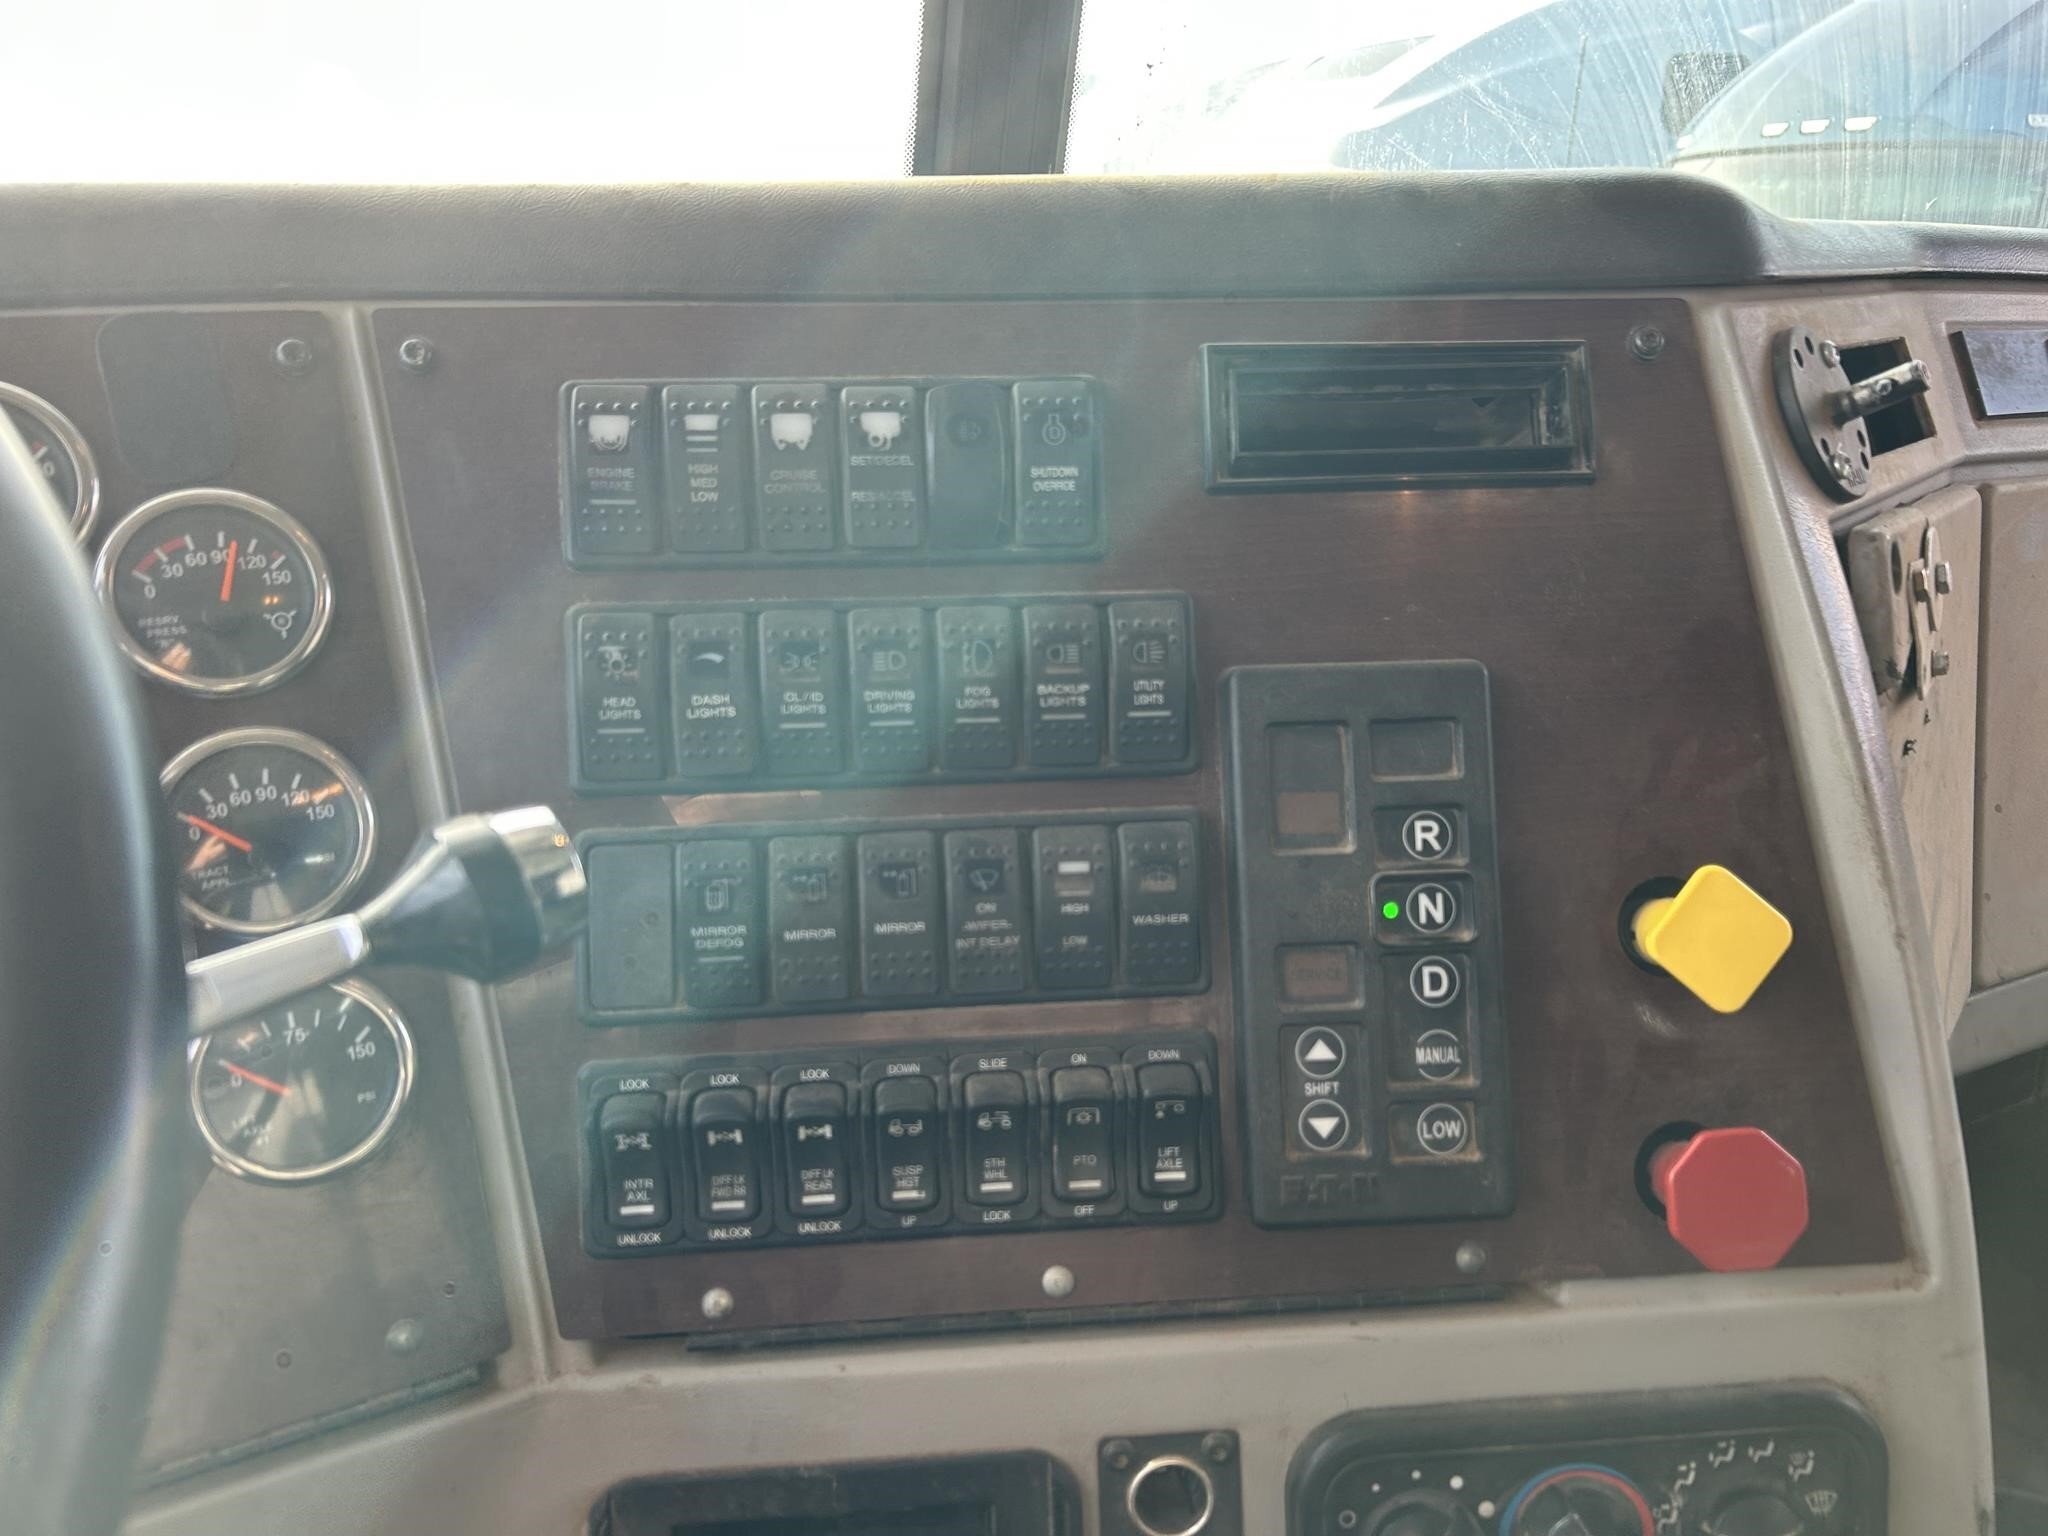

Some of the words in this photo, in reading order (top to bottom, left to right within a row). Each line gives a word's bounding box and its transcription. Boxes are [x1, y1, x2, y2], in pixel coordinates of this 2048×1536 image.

[687, 463, 719, 475] HIGH
[1030, 465, 1080, 479] SHUTDOWN
[690, 477, 718, 489] MED
[690, 490, 719, 504] LOW
[185, 552, 208, 567] 60
[237, 554, 266, 570] 120
[161, 563, 184, 579] 30
[262, 571, 292, 587] 150
[144, 585, 156, 600] 0
[1037, 683, 1090, 696] BACKUP
[603, 697, 636, 708] HEAD
[691, 695, 731, 706] DASH
[957, 698, 999, 709] LIGHTS
[1040, 696, 1086, 708] LIGHTS
[1133, 693, 1165, 706] LIGHTS
[599, 709, 642, 720] LIGHTS
[686, 707, 737, 719] LIGHTS
[782, 704, 827, 715] LIGHTS
[868, 702, 912, 714] LIGHTS
[229, 790, 252, 805] 60
[254, 786, 277, 801] 90
[206, 804, 228, 819] 30
[305, 803, 336, 821] 150
[188, 827, 201, 841] 0
[1413, 819, 1442, 853] R
[976, 902, 997, 914] ON
[1061, 903, 1089, 915] HIGH
[1417, 891, 1445, 925] N
[1132, 913, 1189, 926] WASHER
[691, 924, 746, 937] MIRROR
[874, 921, 926, 935] MIRROR
[784, 928, 837, 942] MIRROR
[1062, 935, 1088, 947] LOW
[696, 938, 744, 949] DEFOG
[1421, 964, 1449, 998] D
[347, 1040, 376, 1061] 150
[1148, 1049, 1180, 1061] DOWN
[1415, 1046, 1462, 1066] MANUAL
[978, 1058, 1008, 1070] SLIDE
[1071, 1053, 1087, 1064] ON
[800, 1068, 830, 1081] LOCK
[888, 1063, 920, 1075] DOWN
[620, 1079, 649, 1091] LOCK
[710, 1074, 740, 1087] LOCK
[1304, 1080, 1341, 1098] SHIFT
[1421, 1119, 1461, 1141] LOW
[1158, 1146, 1181, 1158] LIFT
[1073, 1154, 1097, 1166] PTO
[1155, 1157, 1184, 1170] AXLE
[893, 1165, 924, 1176] SUSP
[627, 1191, 651, 1202] AXL
[1074, 1205, 1097, 1217] OFF
[1163, 1199, 1178, 1212] UP
[902, 1215, 918, 1226] UP
[983, 1210, 1011, 1222] LOCK
[709, 1226, 752, 1240] UNLOCK
[799, 1221, 841, 1234] UNLOCK
[618, 1232, 662, 1246] UNLOCK
